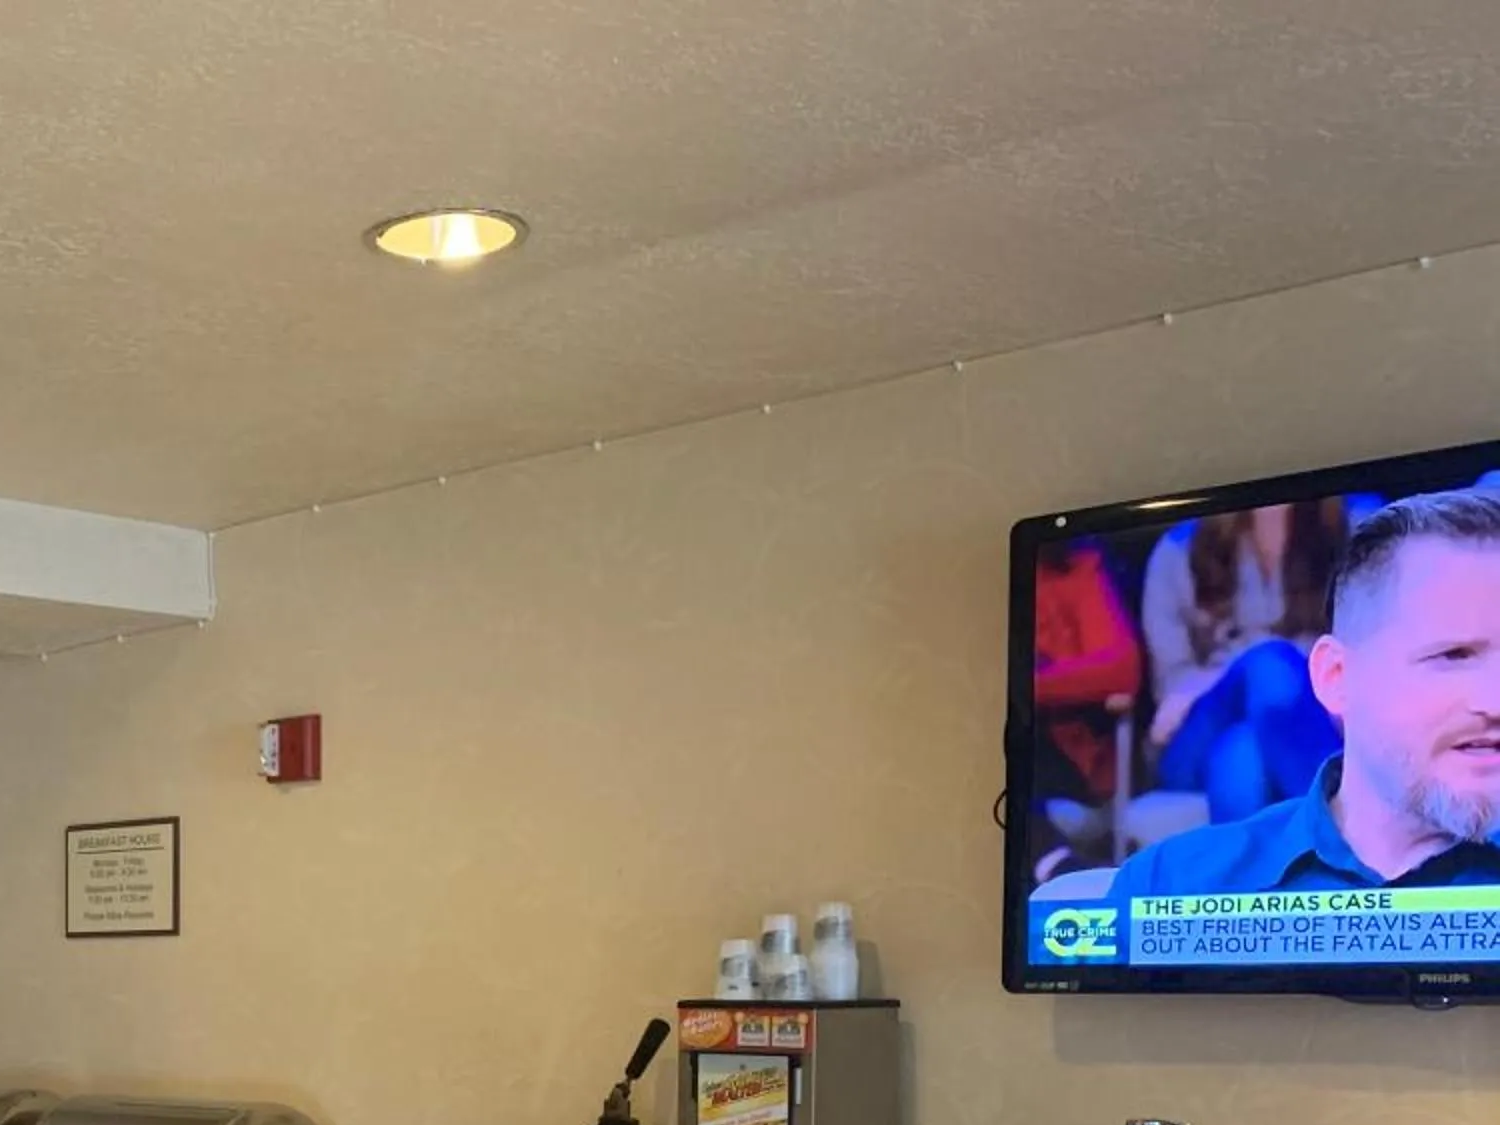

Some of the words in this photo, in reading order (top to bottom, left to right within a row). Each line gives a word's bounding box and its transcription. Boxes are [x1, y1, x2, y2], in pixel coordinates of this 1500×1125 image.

[1142, 899, 1184, 915] THE
[1190, 897, 1242, 914] JODI
[1250, 895, 1320, 914] ARIAS
[1329, 893, 1392, 911] CASE
[1078, 926, 1117, 938] CRIME
[1142, 919, 1195, 936] BEST
[1203, 917, 1285, 935] FRIEND
[1293, 915, 1325, 933] OF
[1333, 913, 1421, 932] TRAVIS
[1429, 911, 1500, 931] ALEX
[1141, 937, 1188, 954] OUT
[1194, 935, 1272, 954] ABOUT
[1280, 934, 1324, 953] THE
[1333, 933, 1413, 952] FATAL
[1419, 972, 1471, 984] PHILIPS
